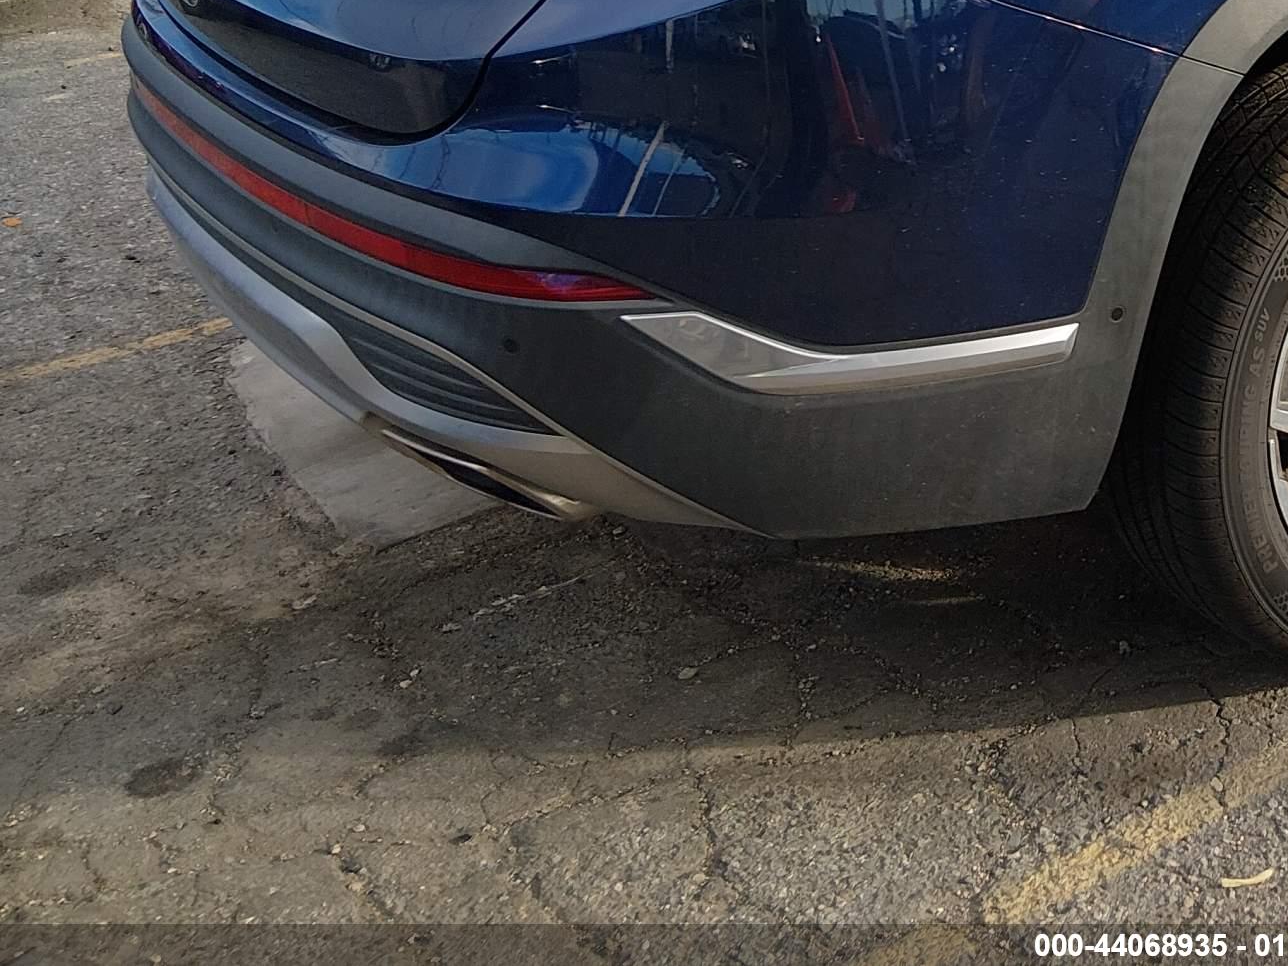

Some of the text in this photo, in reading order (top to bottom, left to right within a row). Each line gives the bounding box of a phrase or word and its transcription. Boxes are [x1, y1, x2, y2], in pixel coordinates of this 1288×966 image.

[1239, 307, 1279, 574] PREMIER TOURING AS SUV
